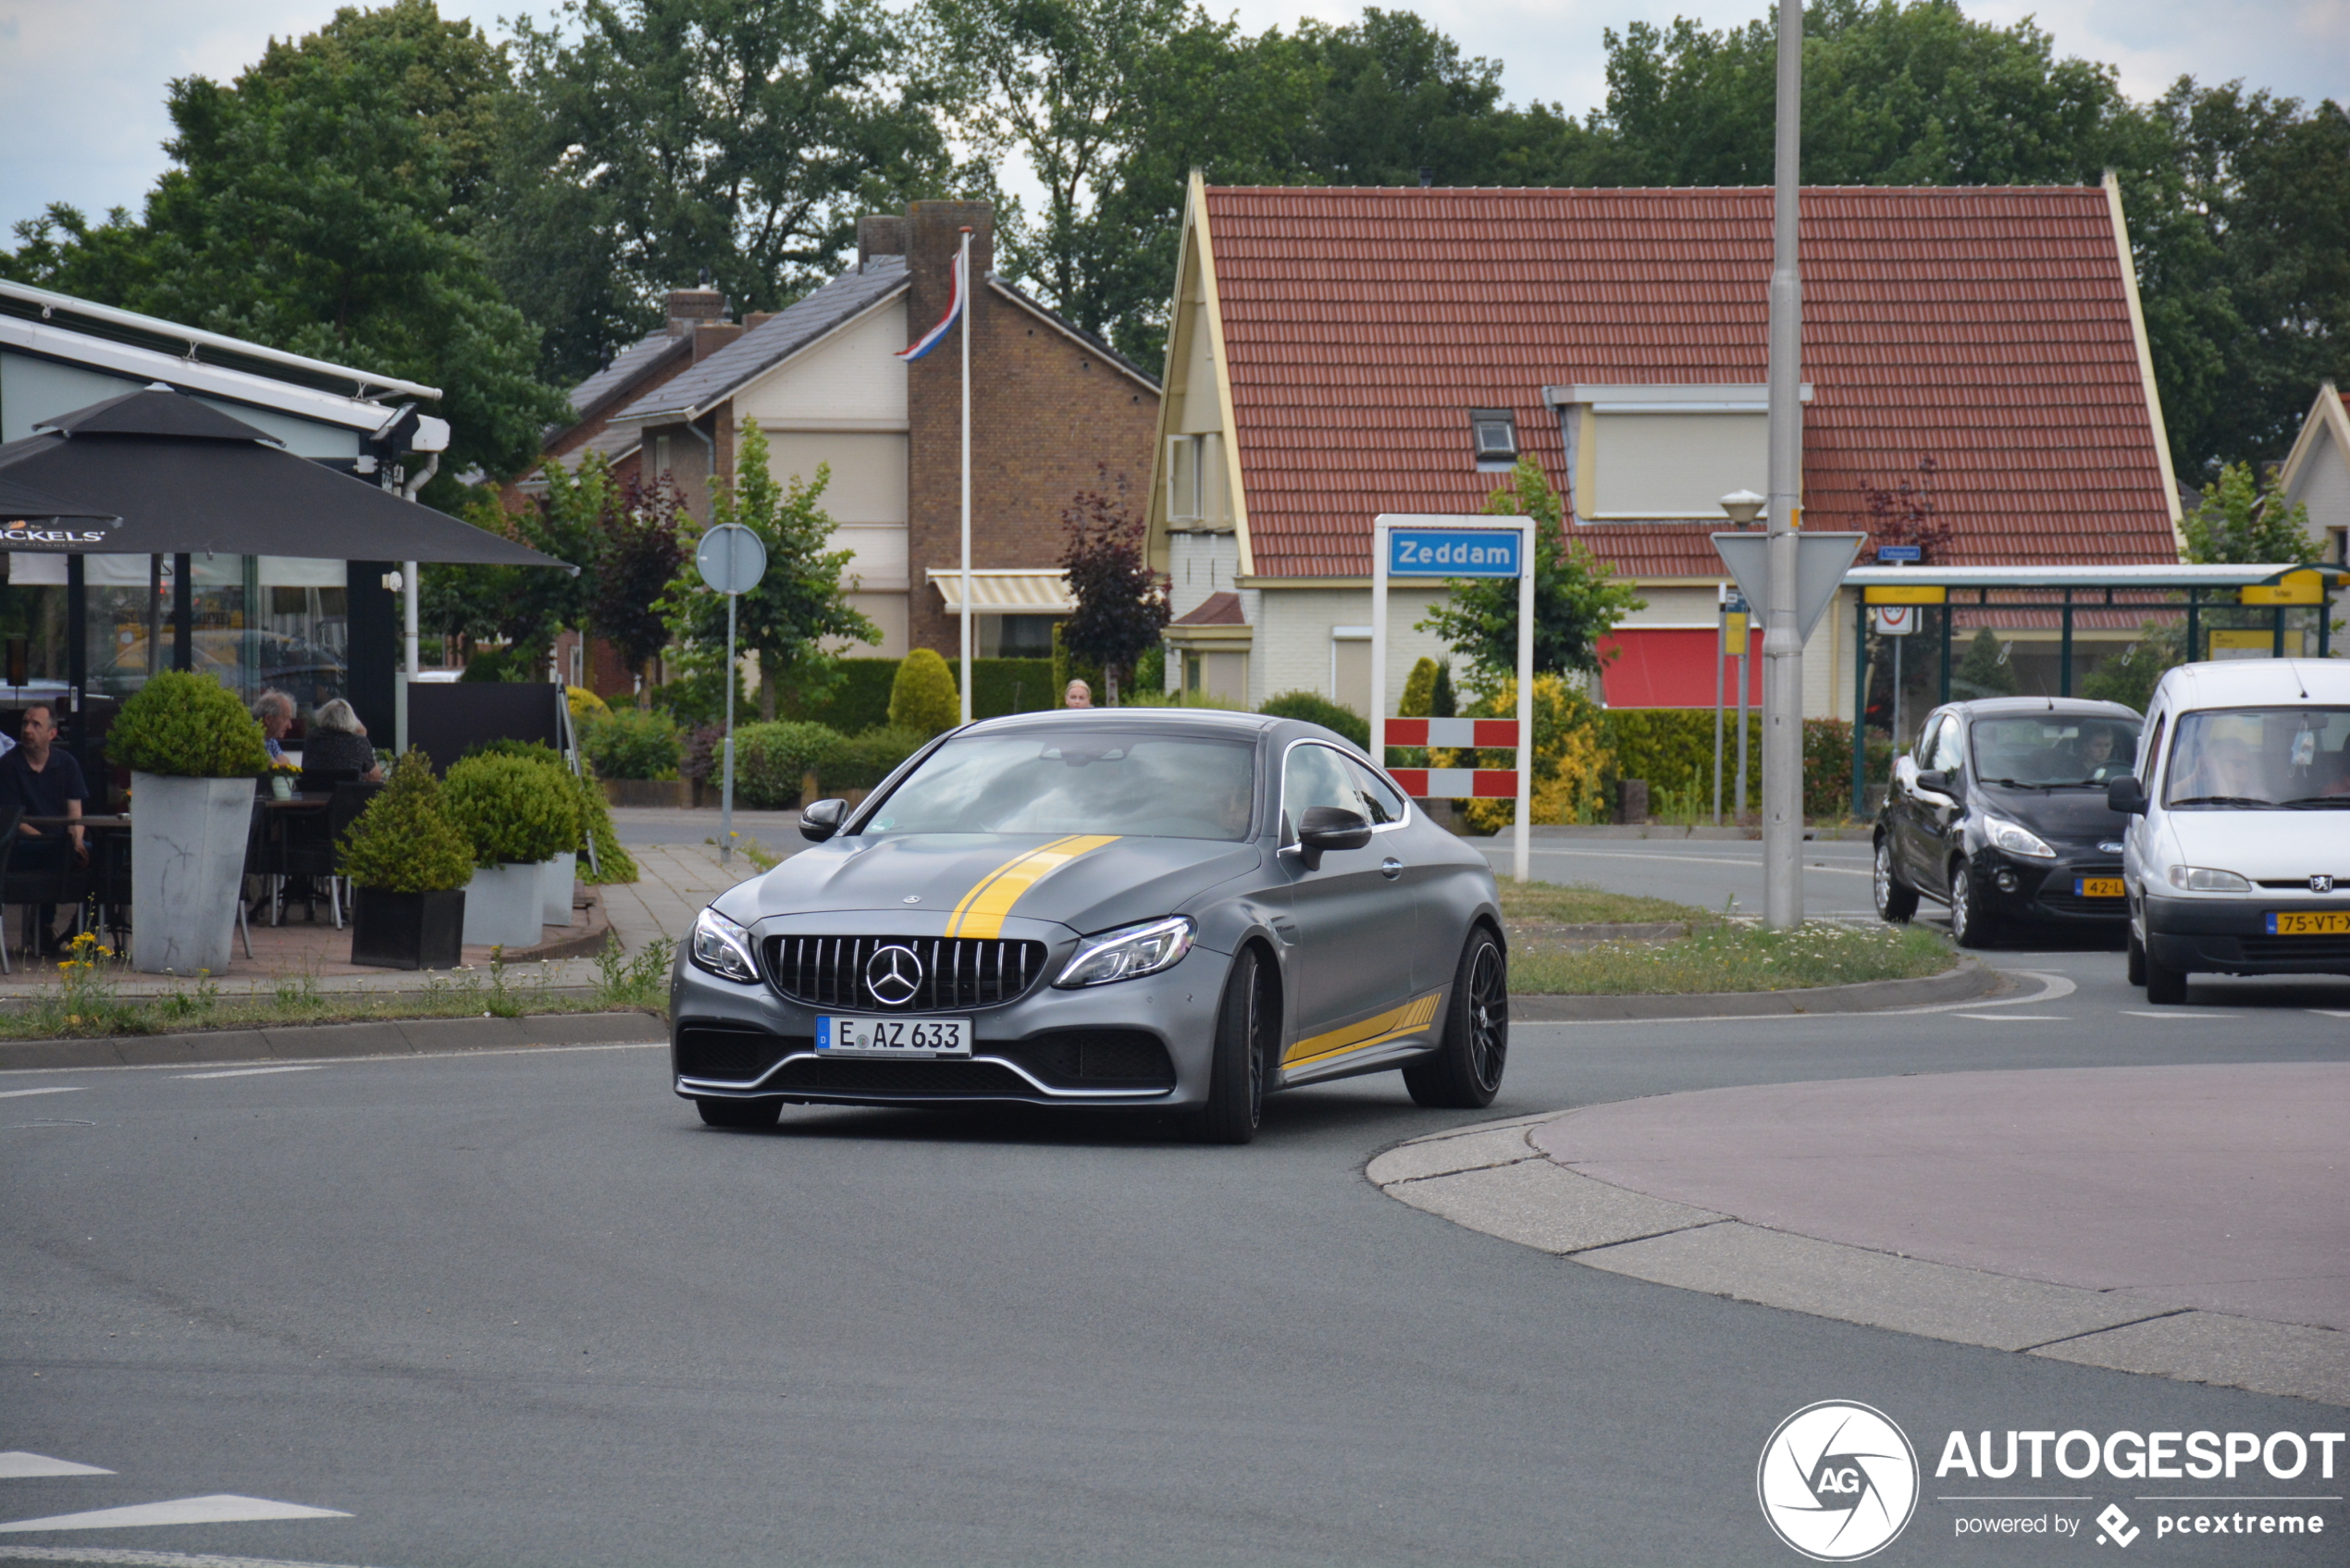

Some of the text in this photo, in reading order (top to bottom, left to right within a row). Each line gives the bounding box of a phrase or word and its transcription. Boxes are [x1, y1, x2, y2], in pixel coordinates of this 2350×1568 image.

[1399, 541, 1510, 564] Zeddam
[840, 1021, 959, 1048] E AZ 633
